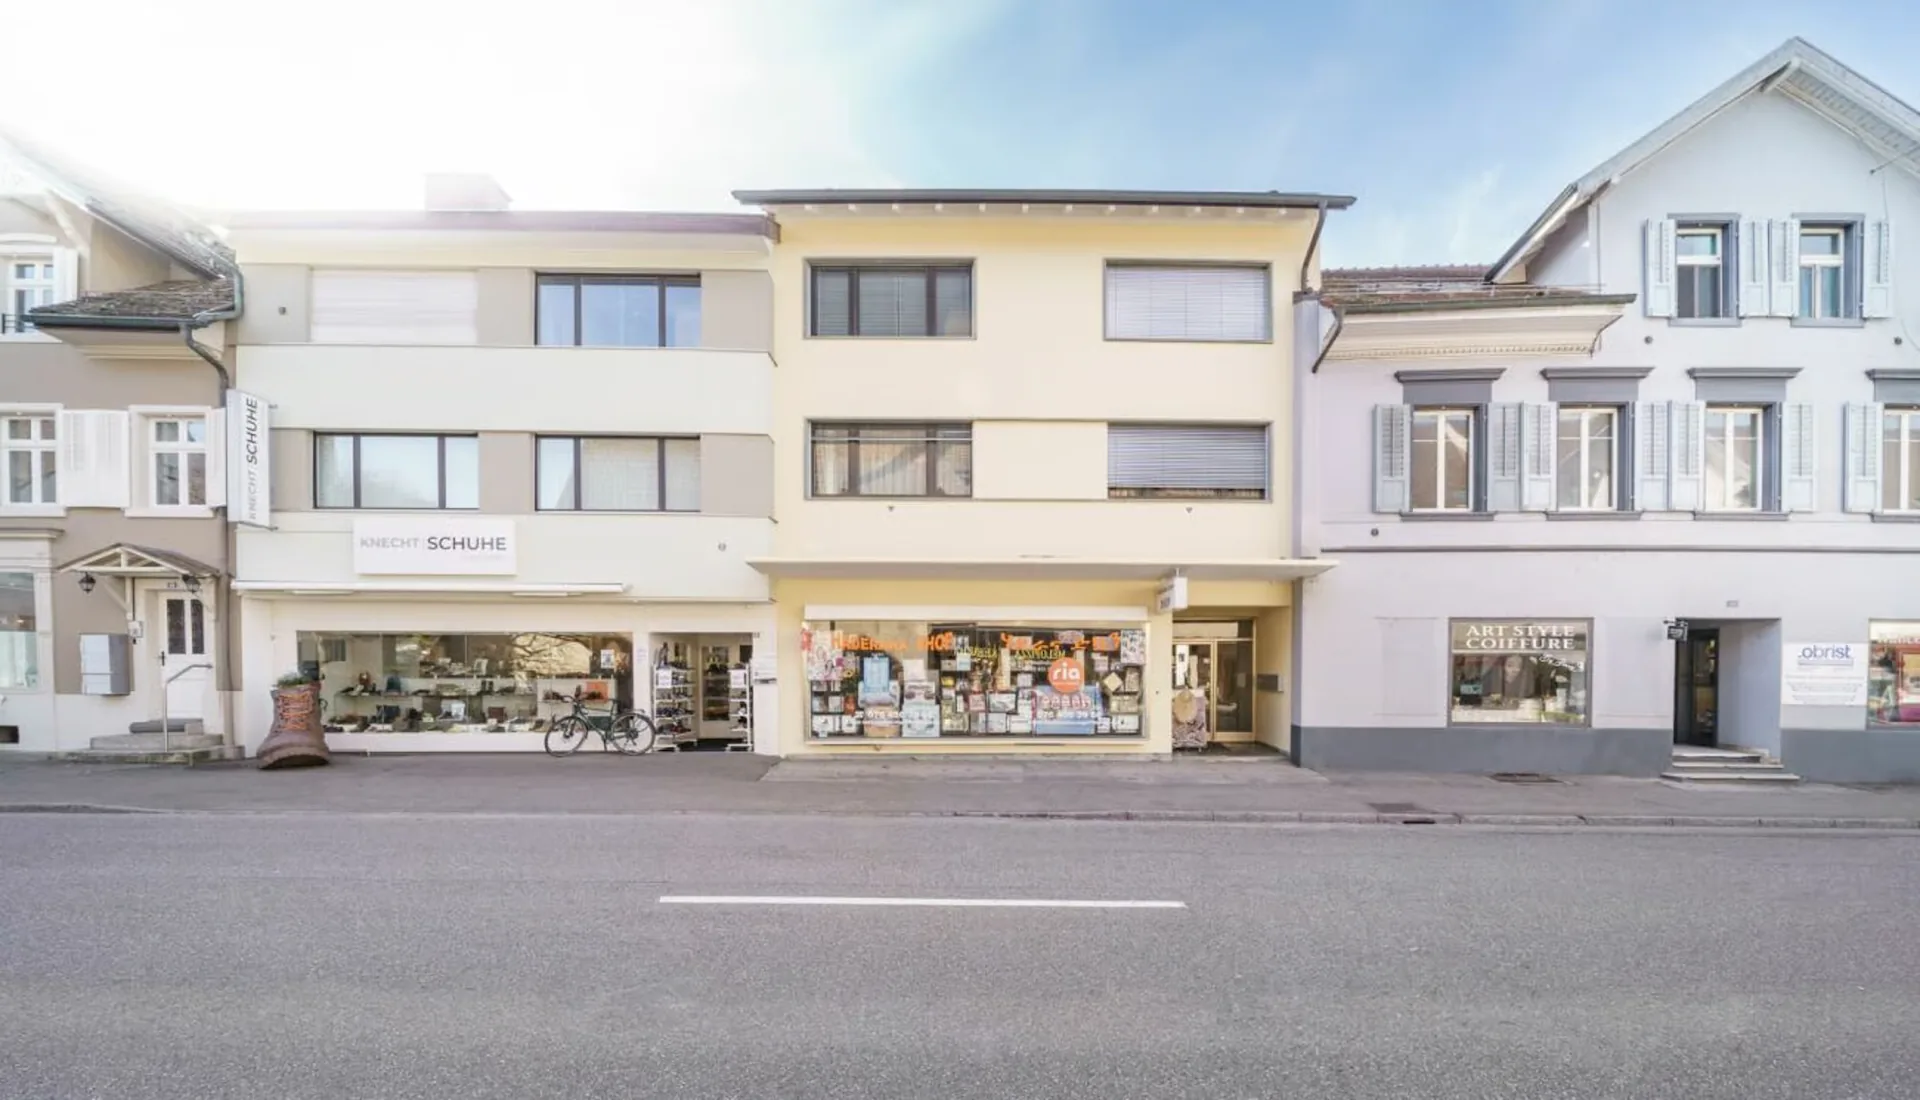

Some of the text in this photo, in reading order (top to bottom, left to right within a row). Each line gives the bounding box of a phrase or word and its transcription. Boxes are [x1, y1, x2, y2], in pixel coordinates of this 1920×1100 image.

[246, 398, 257, 465] SCHUHE
[360, 536, 507, 550] KNECHT SCHUHE
[1466, 625, 1576, 637] ART STYLE
[1466, 637, 1576, 649] COIFFURE
[1052, 663, 1080, 680] ria
